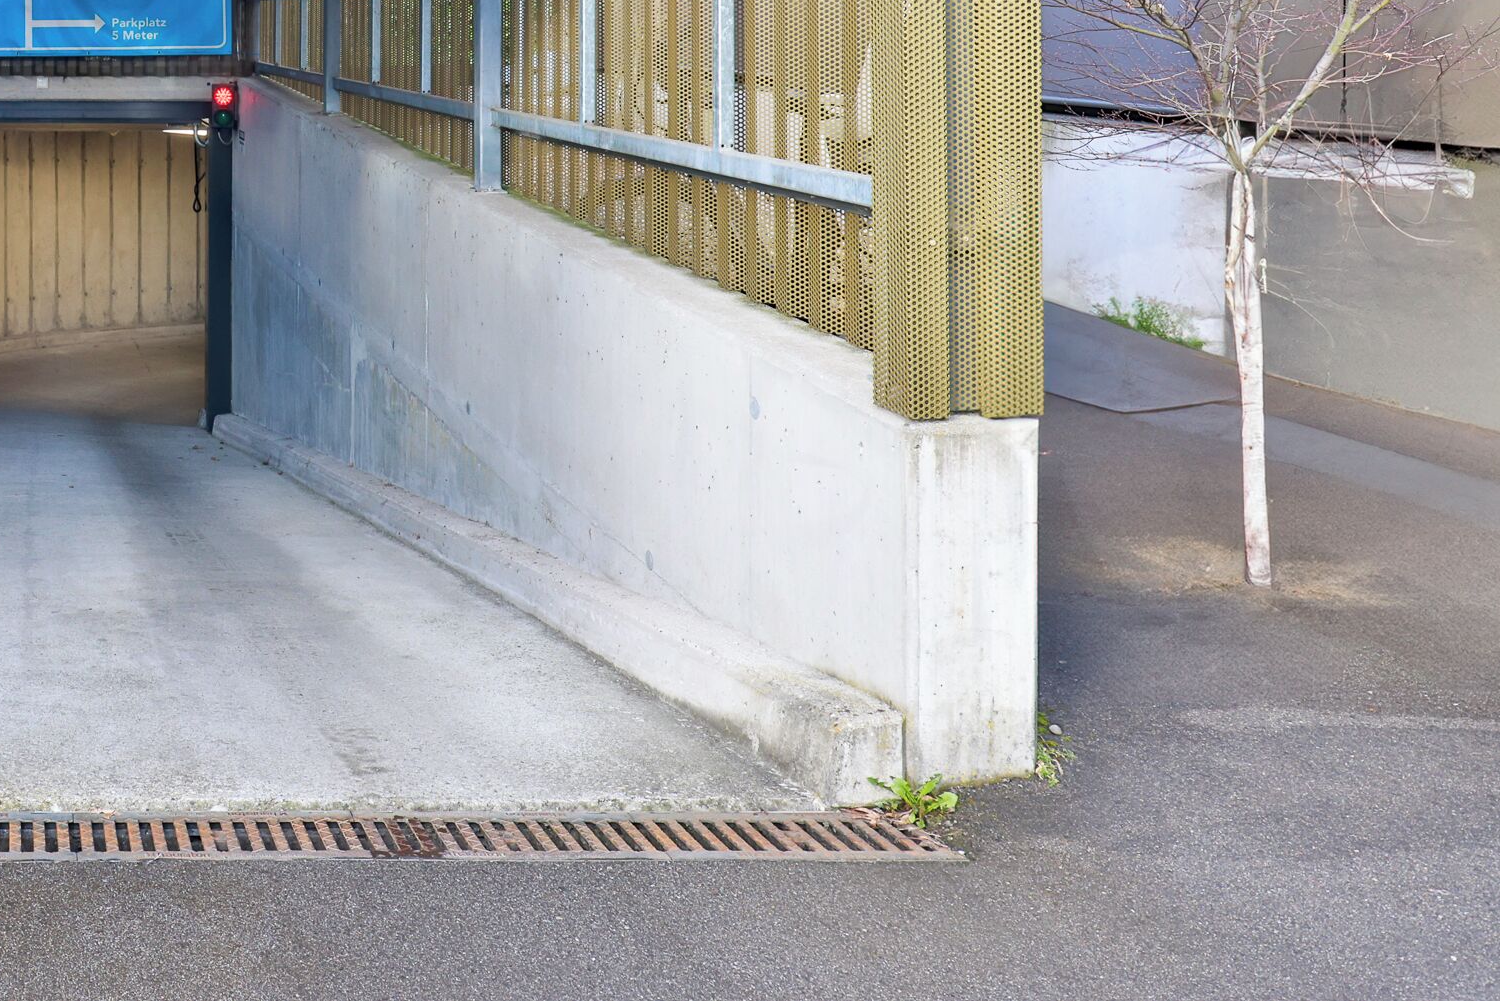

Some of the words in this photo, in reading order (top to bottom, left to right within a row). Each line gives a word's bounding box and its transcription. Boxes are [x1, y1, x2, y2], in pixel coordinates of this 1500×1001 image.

[111, 17, 167, 30] Parkplatz
[111, 30, 119, 40] 5
[122, 30, 158, 40] Meter
